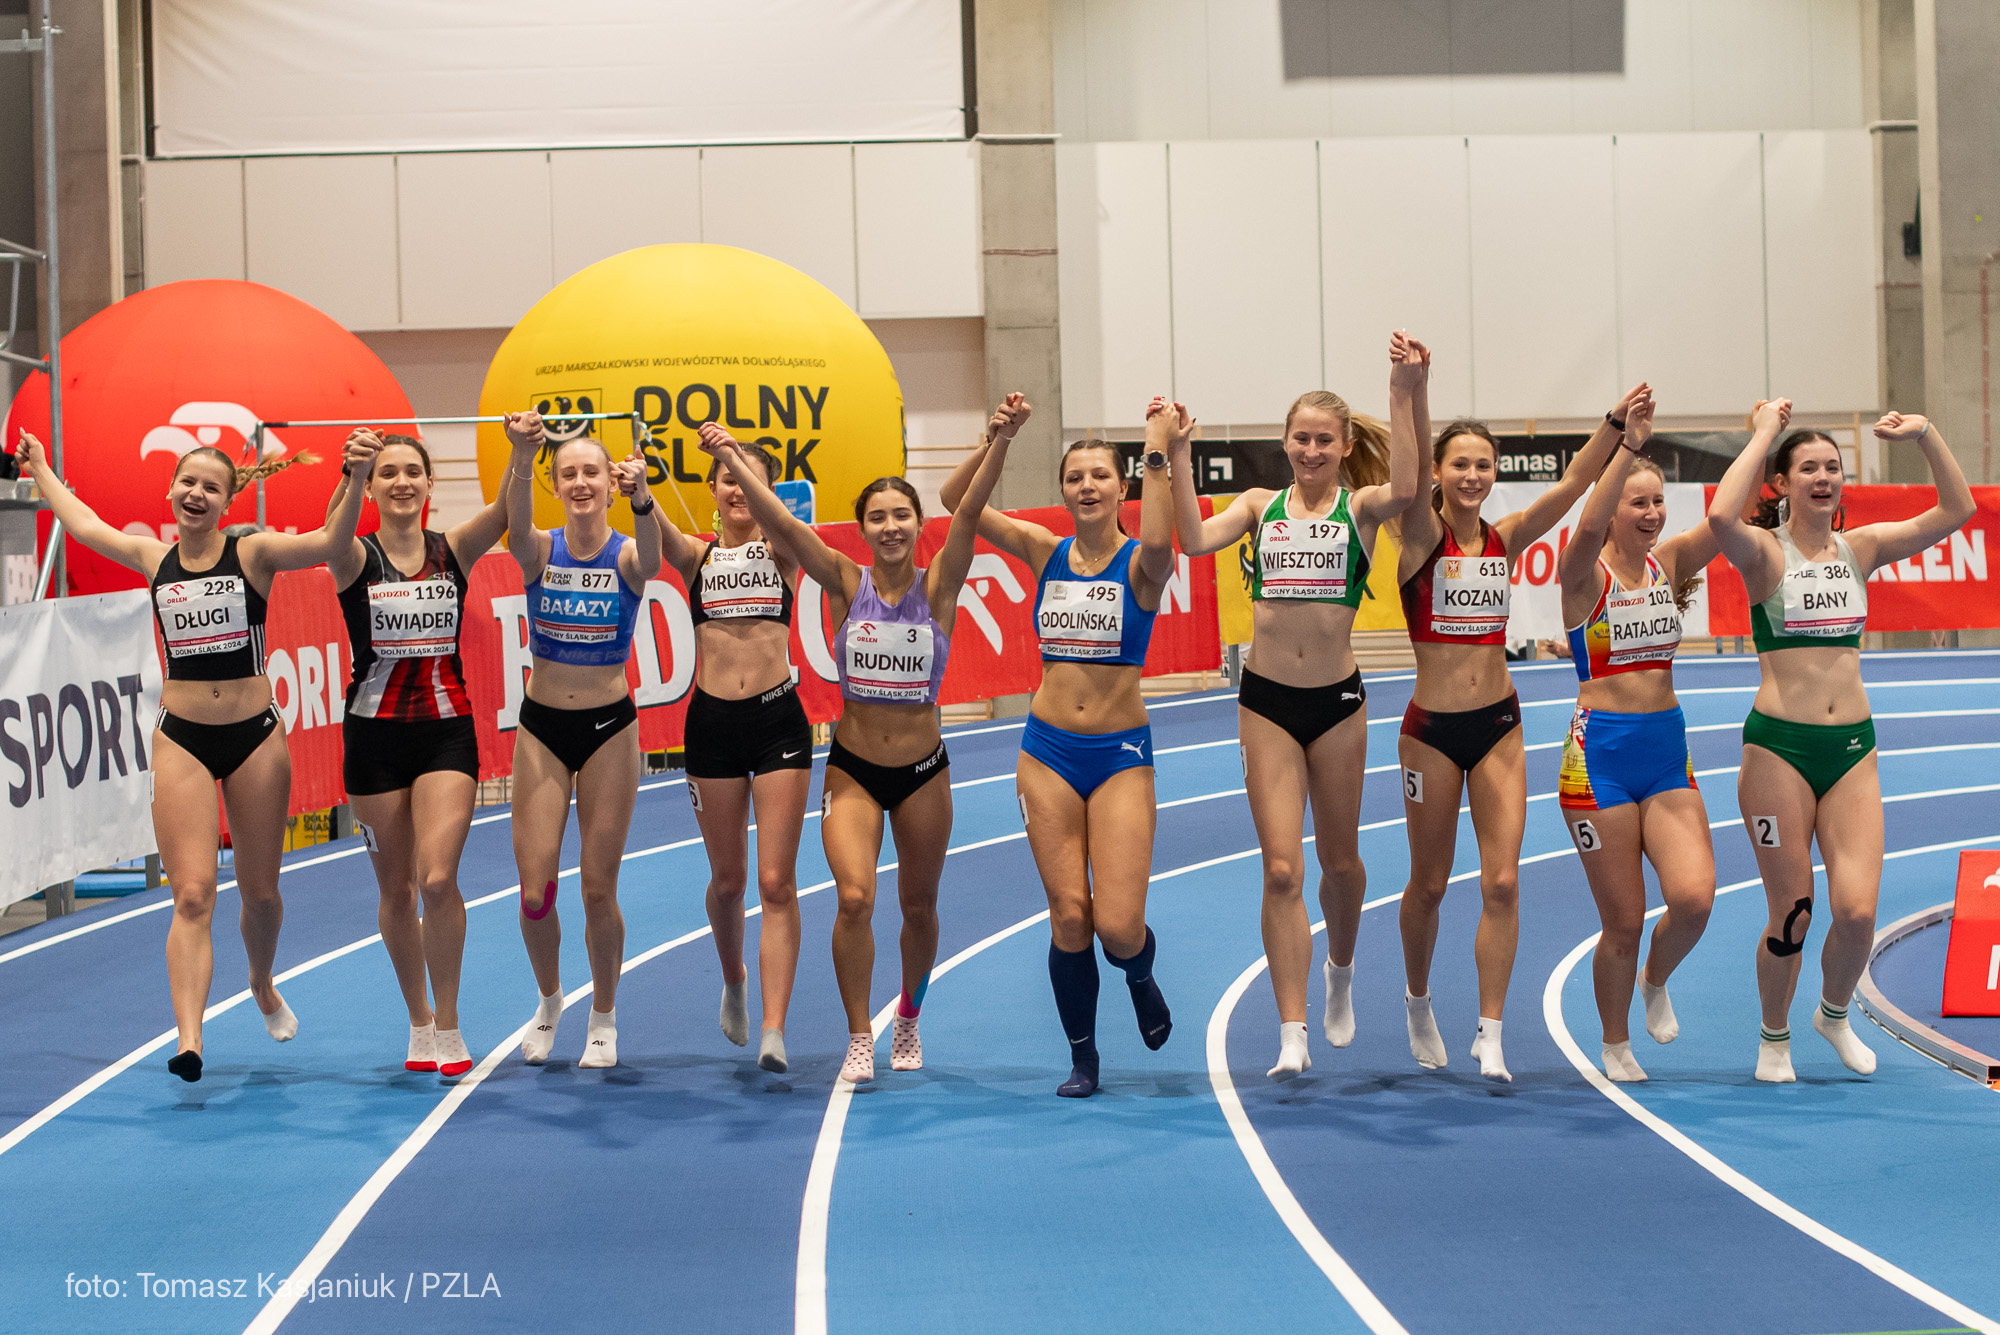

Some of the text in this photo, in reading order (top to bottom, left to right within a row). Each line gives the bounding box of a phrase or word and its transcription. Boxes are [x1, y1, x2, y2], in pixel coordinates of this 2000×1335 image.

[535, 354, 826, 376] URZĄD MARSZAŁKOWSKI WOJEWÓDZTWA DOLNOŚLĄSKIEGO
[633, 383, 830, 431] DOLNY
[639, 426, 821, 485] ŚLSK
[1309, 524, 1341, 539] 197
[1263, 552, 1344, 569] WIESZTORT
[1479, 562, 1505, 577] 613
[1824, 565, 1850, 580] 386
[204, 580, 235, 596] 228
[581, 573, 612, 588] 877
[704, 571, 780, 592] MRUGAŁA
[372, 590, 410, 600] BODZIO
[415, 585, 455, 600] 1196
[1086, 586, 1117, 601] 495
[1292, 587, 1317, 596] ŚLĄSK
[1444, 589, 1504, 606] KOZAN
[1648, 589, 1673, 606] 102
[167, 597, 187, 605] ORLEN
[540, 596, 612, 618] BAŁAZY
[1610, 597, 1645, 608] BODZIO
[1803, 591, 1848, 610] BANY
[174, 607, 230, 630] DŁUGI
[711, 608, 734, 617] DOLNY
[736, 606, 760, 614] ŚLĄSK
[375, 610, 454, 632] ŚWIĄDER
[1041, 609, 1118, 631] ODOLIŃSKA
[565, 633, 590, 641] ŚLĄSK
[906, 629, 917, 643] 3
[1467, 625, 1488, 633] ŚLĄSK
[175, 640, 241, 656] DOLNY ŚLĄSK 2024
[381, 648, 407, 656] DOLNY
[408, 647, 432, 656] ŚLĄSK
[1047, 646, 1069, 654] DOLNY
[854, 651, 925, 672] RUDNIK
[761, 686, 783, 704] NIKE
[878, 689, 903, 698] ŚLĄSK
[0, 673, 148, 808] SPORT
[915, 755, 937, 773] NIKE
[1406, 771, 1417, 798] 5
[1577, 822, 1594, 849] 5
[1757, 818, 1774, 845] 2
[537, 1024, 552, 1032] 4F
